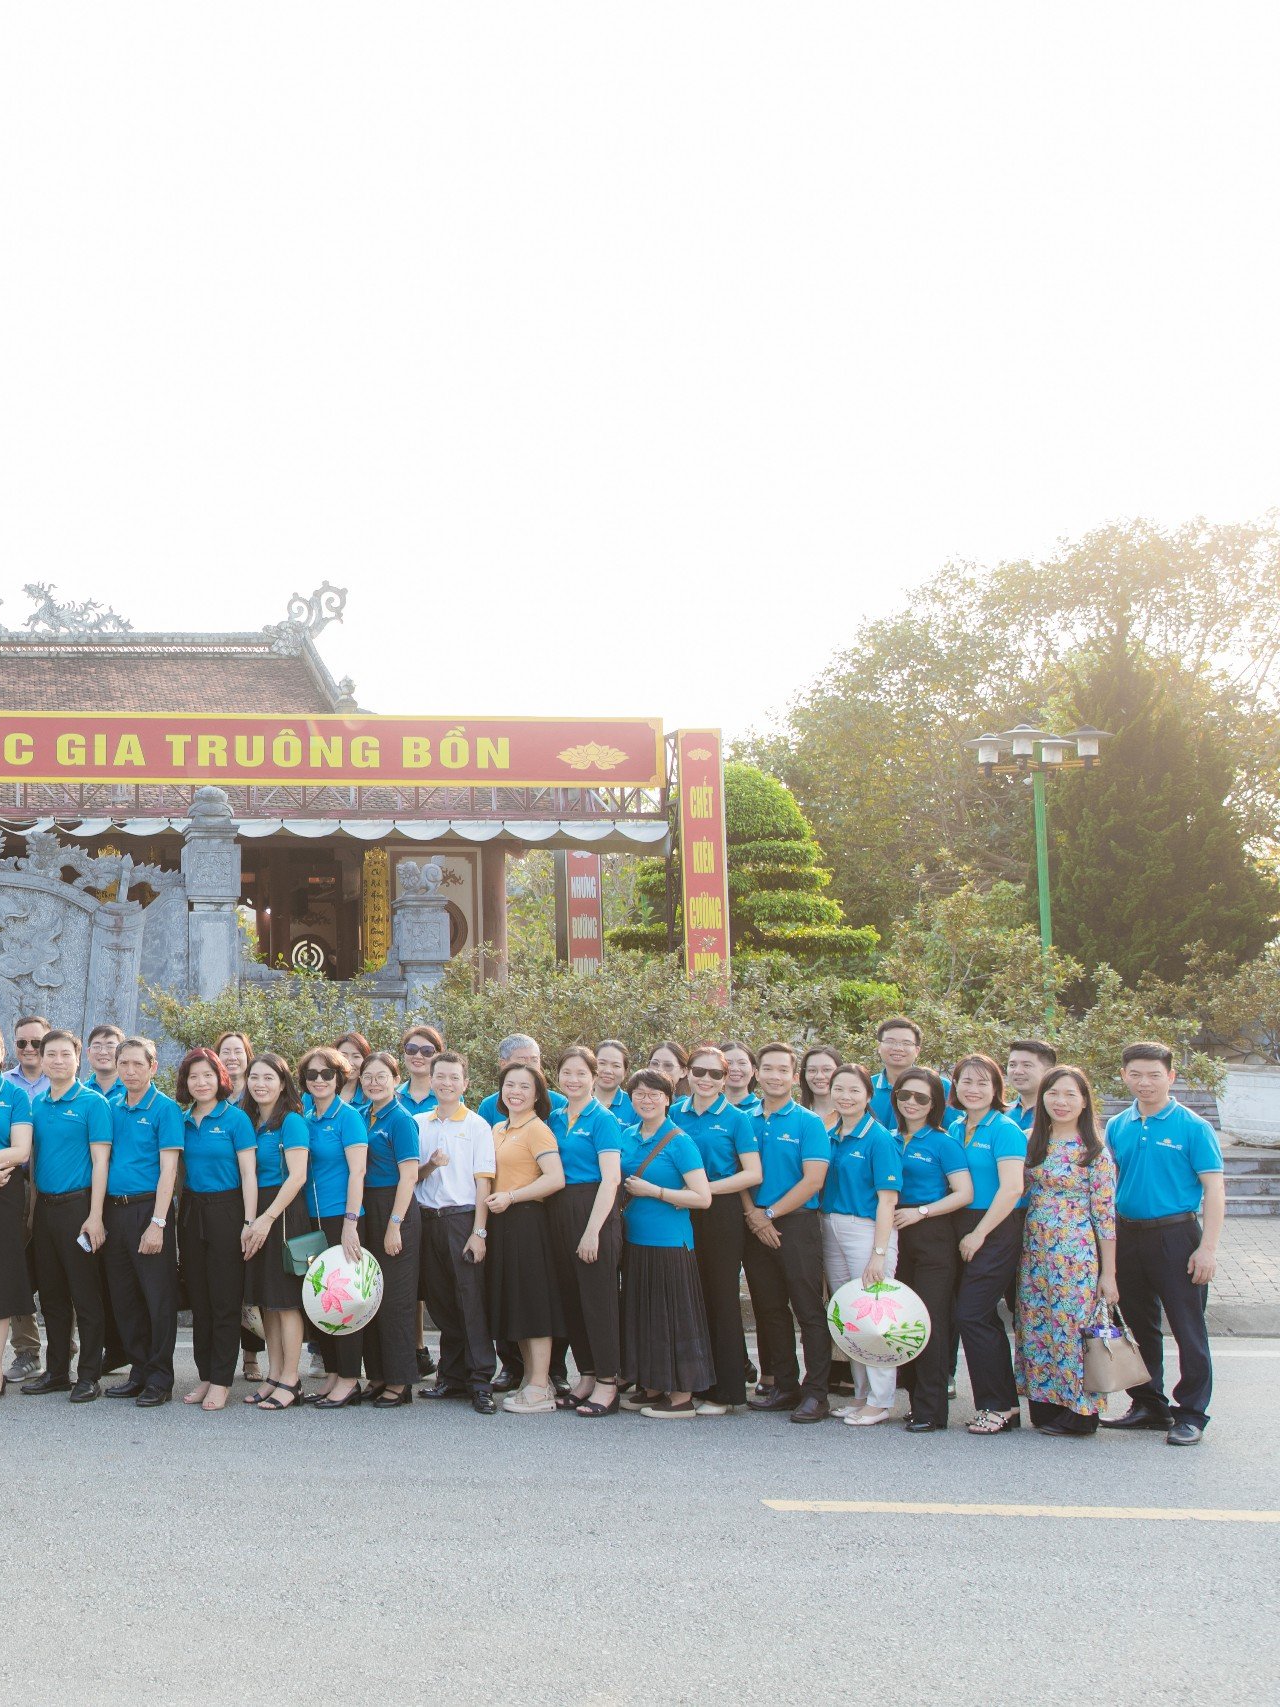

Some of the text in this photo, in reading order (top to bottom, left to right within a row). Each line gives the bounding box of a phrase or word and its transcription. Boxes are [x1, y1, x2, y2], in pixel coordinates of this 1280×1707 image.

[56, 733, 145, 767] GIA
[165, 728, 381, 768] TRUÔNG
[401, 726, 510, 769] BỒN
[689, 775, 714, 819] CHẾT
[692, 835, 715, 874] KIÊN
[689, 891, 723, 930] CƯỜNG
